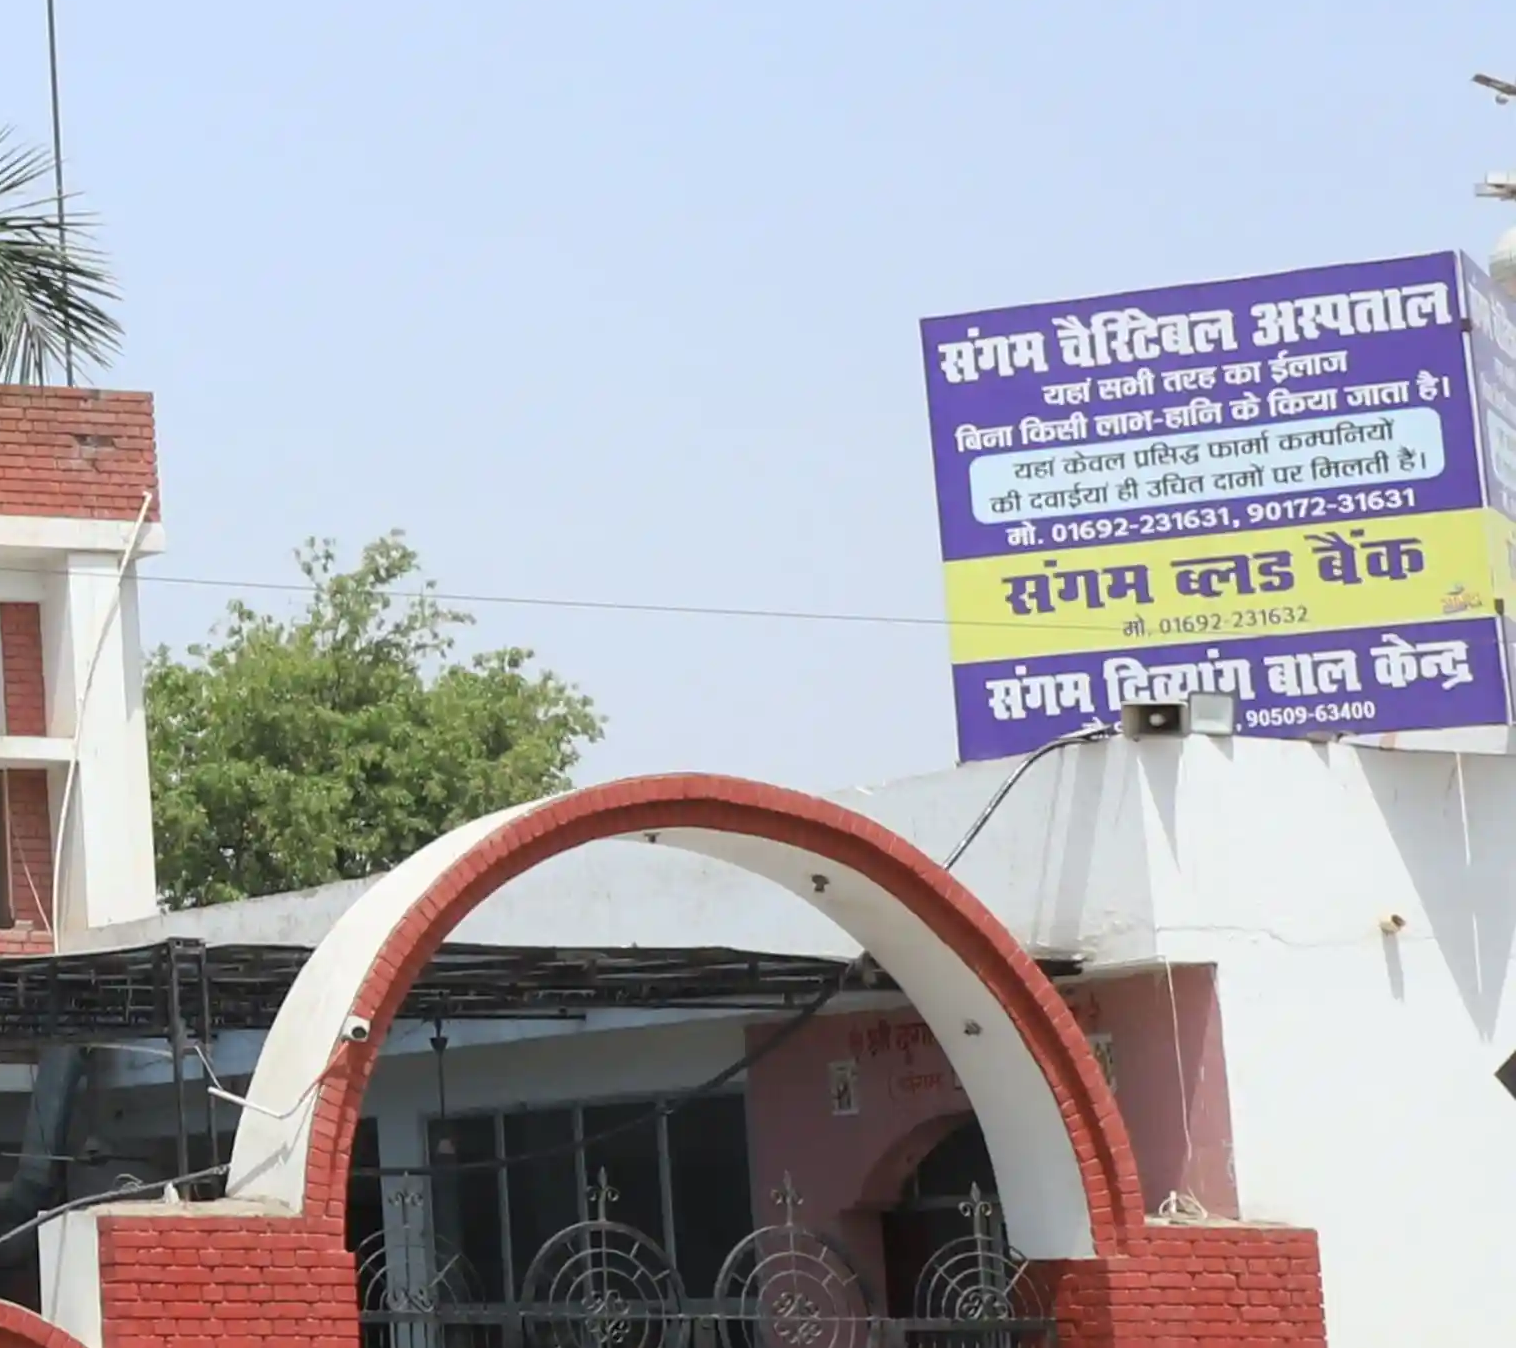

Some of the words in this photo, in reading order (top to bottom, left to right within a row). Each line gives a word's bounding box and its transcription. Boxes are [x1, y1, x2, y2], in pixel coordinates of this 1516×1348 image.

[938, 327, 1049, 383] संगम
[1251, 282, 1452, 347] अस्पताल
[1042, 377, 1092, 405] यहां
[1097, 367, 1154, 401] सभी
[1161, 365, 1218, 393] तरह
[1223, 361, 1262, 384] का
[1268, 350, 1348, 383] ईलाज
[955, 424, 1013, 452] बिना
[1020, 411, 1088, 445] किसी
[1229, 392, 1261, 421] के
[1267, 388, 1338, 418] किया
[1344, 381, 1409, 407] जाता
[990, 490, 1022, 513] की
[1117, 478, 1138, 500] ही
[1146, 473, 1205, 498] उचित
[1272, 465, 1304, 484] पर
[1311, 450, 1389, 480] मिलती
[1063, 451, 1125, 474] केवल
[1208, 430, 1269, 458] फार्मा
[1052, 506, 1241, 543] 01692-231631,
[1247, 488, 1415, 523] 90172-31631
[1002, 560, 1153, 615] संगम
[1170, 549, 1294, 598] ब्लड
[1304, 528, 1423, 584] बैंक
[1158, 605, 1309, 637] 01692-231632
[985, 665, 1095, 720] संगम
[1265, 648, 1361, 696] बाल
[1246, 699, 1376, 728] 90509-63400
